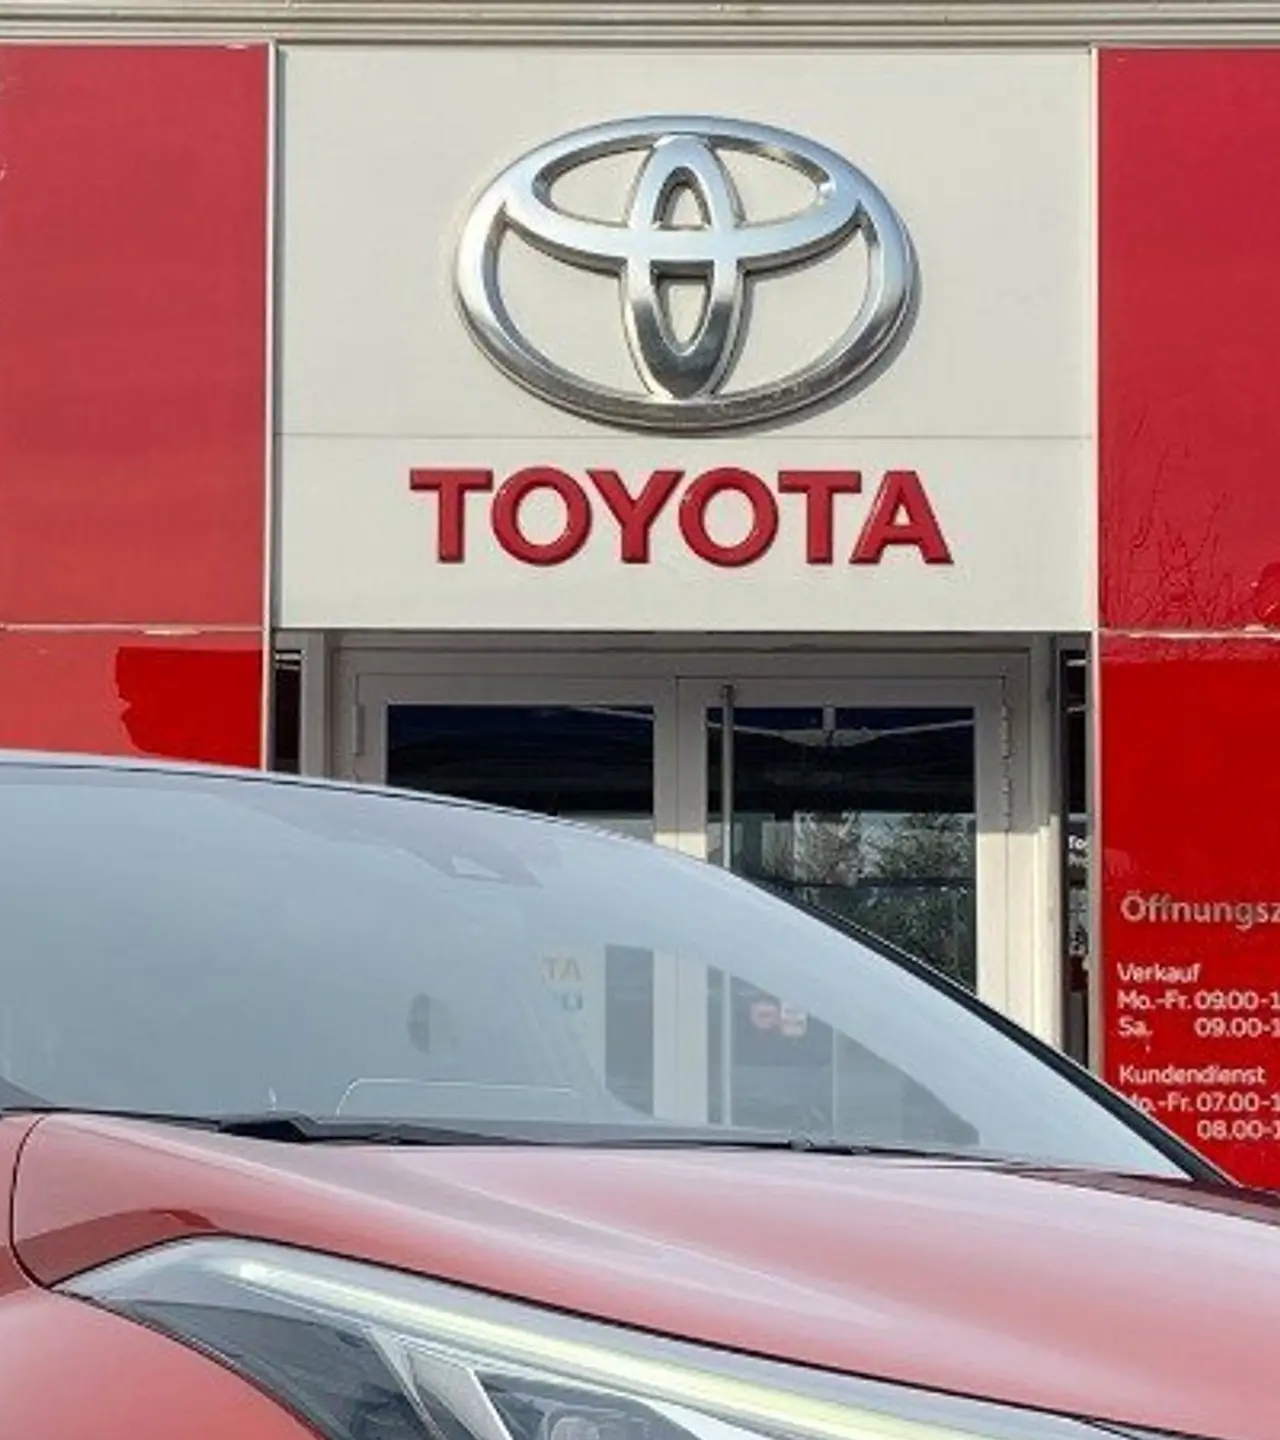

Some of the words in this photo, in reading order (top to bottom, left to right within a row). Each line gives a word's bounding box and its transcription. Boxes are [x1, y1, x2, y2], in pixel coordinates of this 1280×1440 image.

[409, 466, 955, 567] TOYOTA
[1116, 962, 1202, 984] Verkauf
[1117, 989, 1192, 1011] Mo.-Fr.
[1117, 1016, 1153, 1037] Sa.
[1120, 1064, 1267, 1085] Kundendienst
